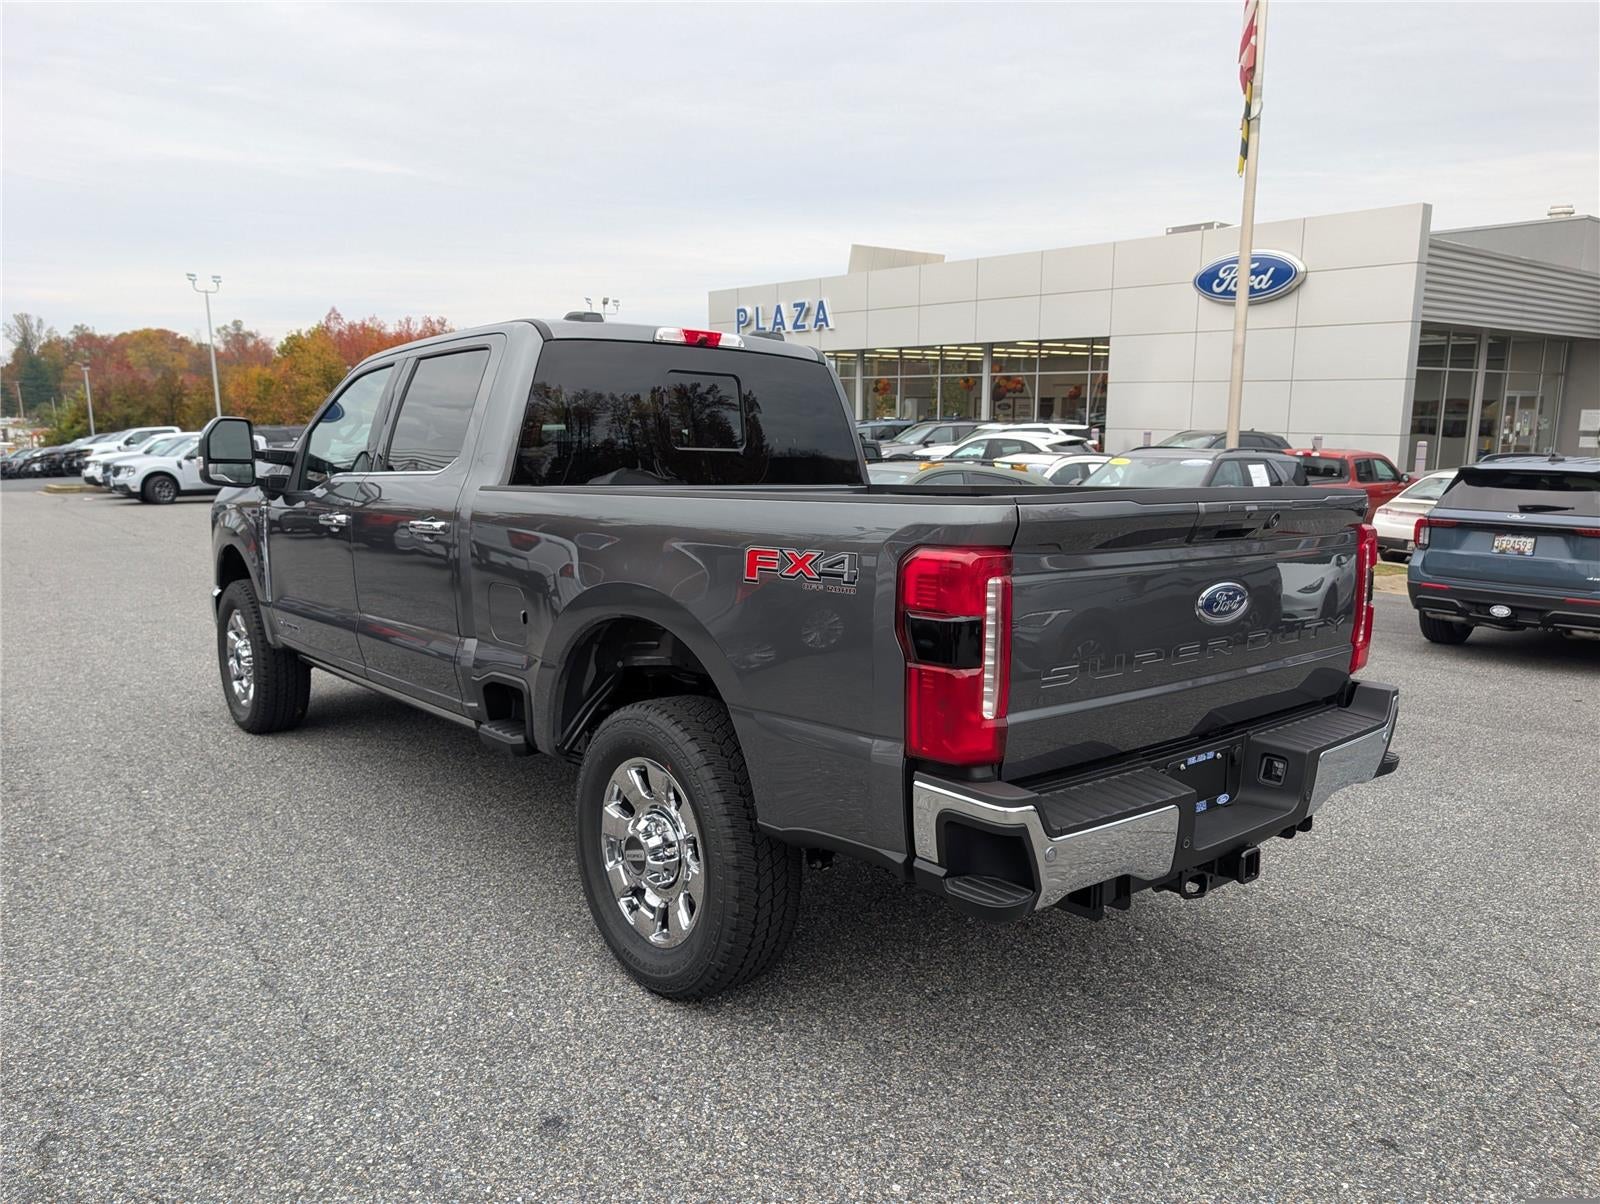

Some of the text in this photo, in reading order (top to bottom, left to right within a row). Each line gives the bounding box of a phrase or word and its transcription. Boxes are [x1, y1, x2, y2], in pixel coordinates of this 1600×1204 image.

[736, 298, 834, 334] PLAZA
[743, 545, 859, 586] FX4
[1213, 591, 1240, 612] Ford
[1040, 614, 1345, 689] SUPER DUTY
